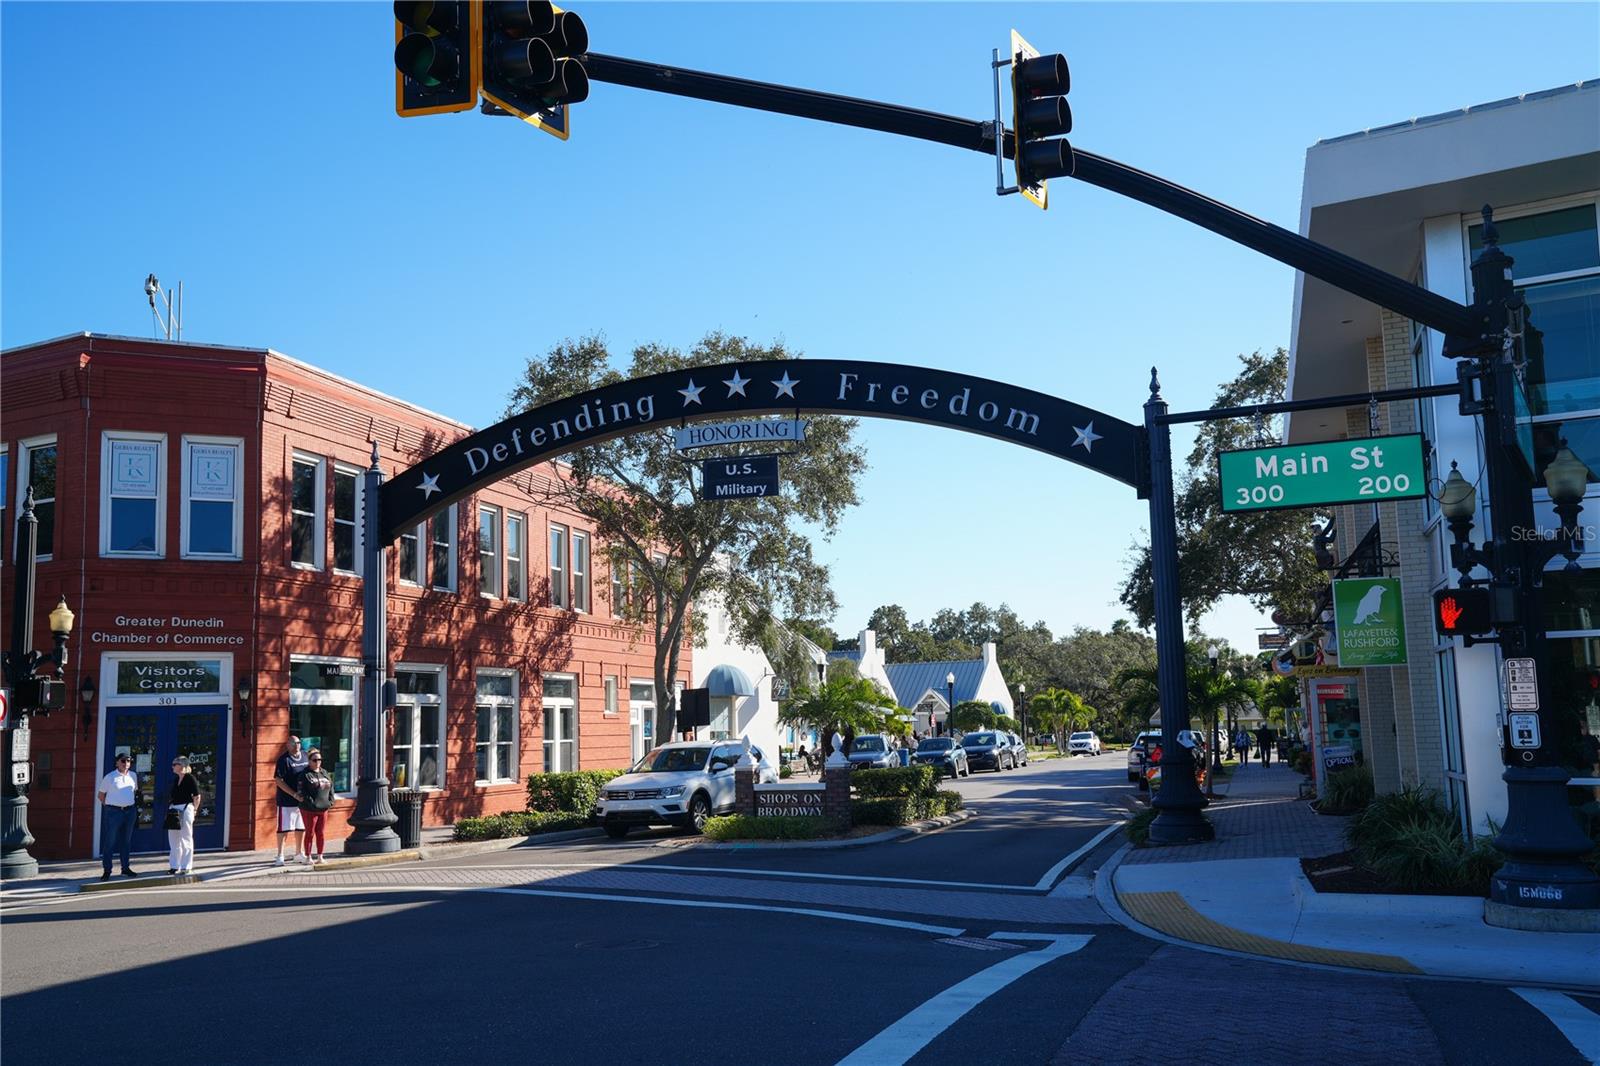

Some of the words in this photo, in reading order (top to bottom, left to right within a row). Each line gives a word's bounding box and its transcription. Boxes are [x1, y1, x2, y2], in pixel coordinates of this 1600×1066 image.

[464, 394, 655, 475] Defending
[836, 373, 1040, 435] Freedom
[689, 422, 789, 444] HONORING
[1255, 452, 1328, 478] Main
[1350, 446, 1384, 470] St
[725, 463, 757, 476] U.S.
[716, 484, 767, 496] Military
[1236, 485, 1284, 505] 300
[1359, 474, 1410, 495] 200
[115, 615, 167, 627] Greater
[171, 617, 224, 628] Dunedin
[91, 632, 152, 644] Chamber
[156, 634, 169, 644] of
[174, 634, 244, 645] Commerce
[1344, 637, 1400, 649] RUSHFORD
[134, 666, 205, 676] Visitors
[327, 667, 340, 675] MAI
[139, 680, 201, 689] Center
[158, 697, 178, 705] 301
[1326, 757, 1353, 768] OPTICAL
[759, 793, 799, 804] SHOPS
[804, 793, 822, 804] ON
[758, 806, 824, 817] BROADWAY
